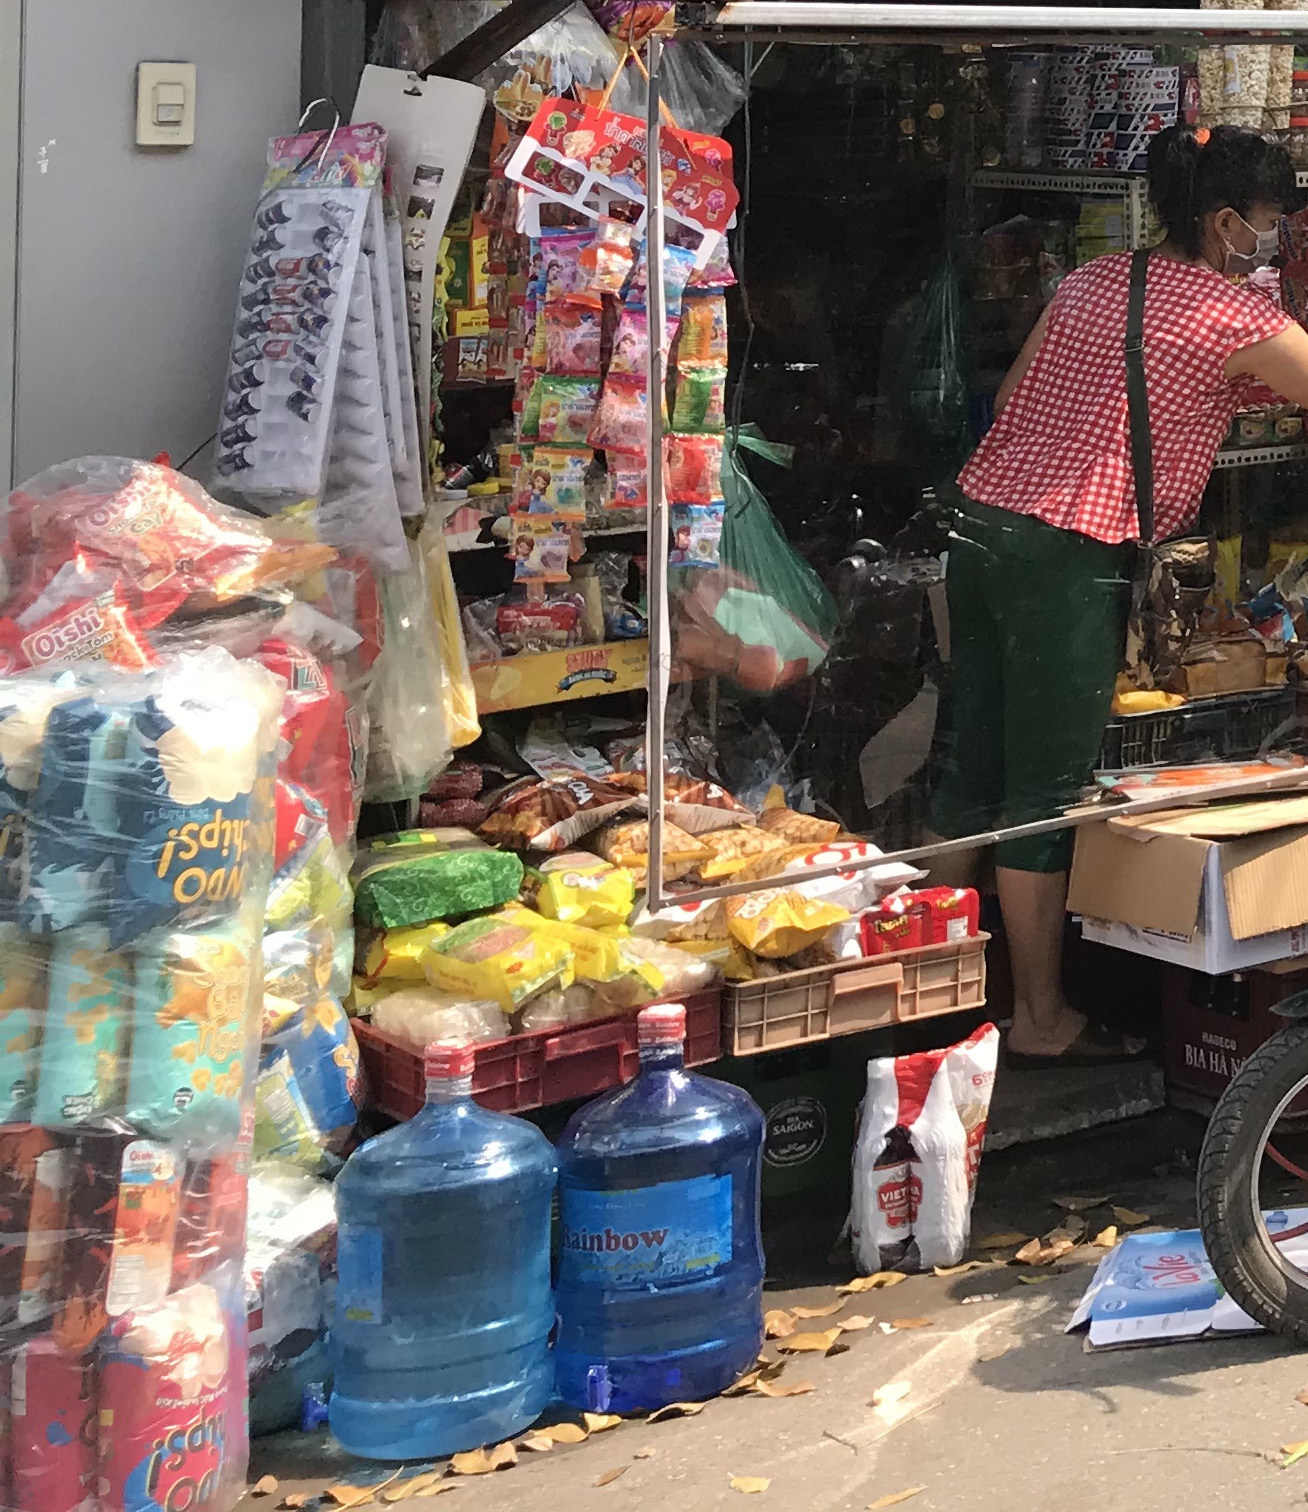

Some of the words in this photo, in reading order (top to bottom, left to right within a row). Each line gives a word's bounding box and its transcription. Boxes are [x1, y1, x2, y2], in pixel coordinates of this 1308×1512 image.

[34, 606, 104, 658] Oishi
[1184, 1043, 1207, 1069] BIA
[1209, 1049, 1229, 1077] HÀ
[771, 1119, 815, 1137] SAIGON
[562, 1224, 670, 1254] Rainbow
